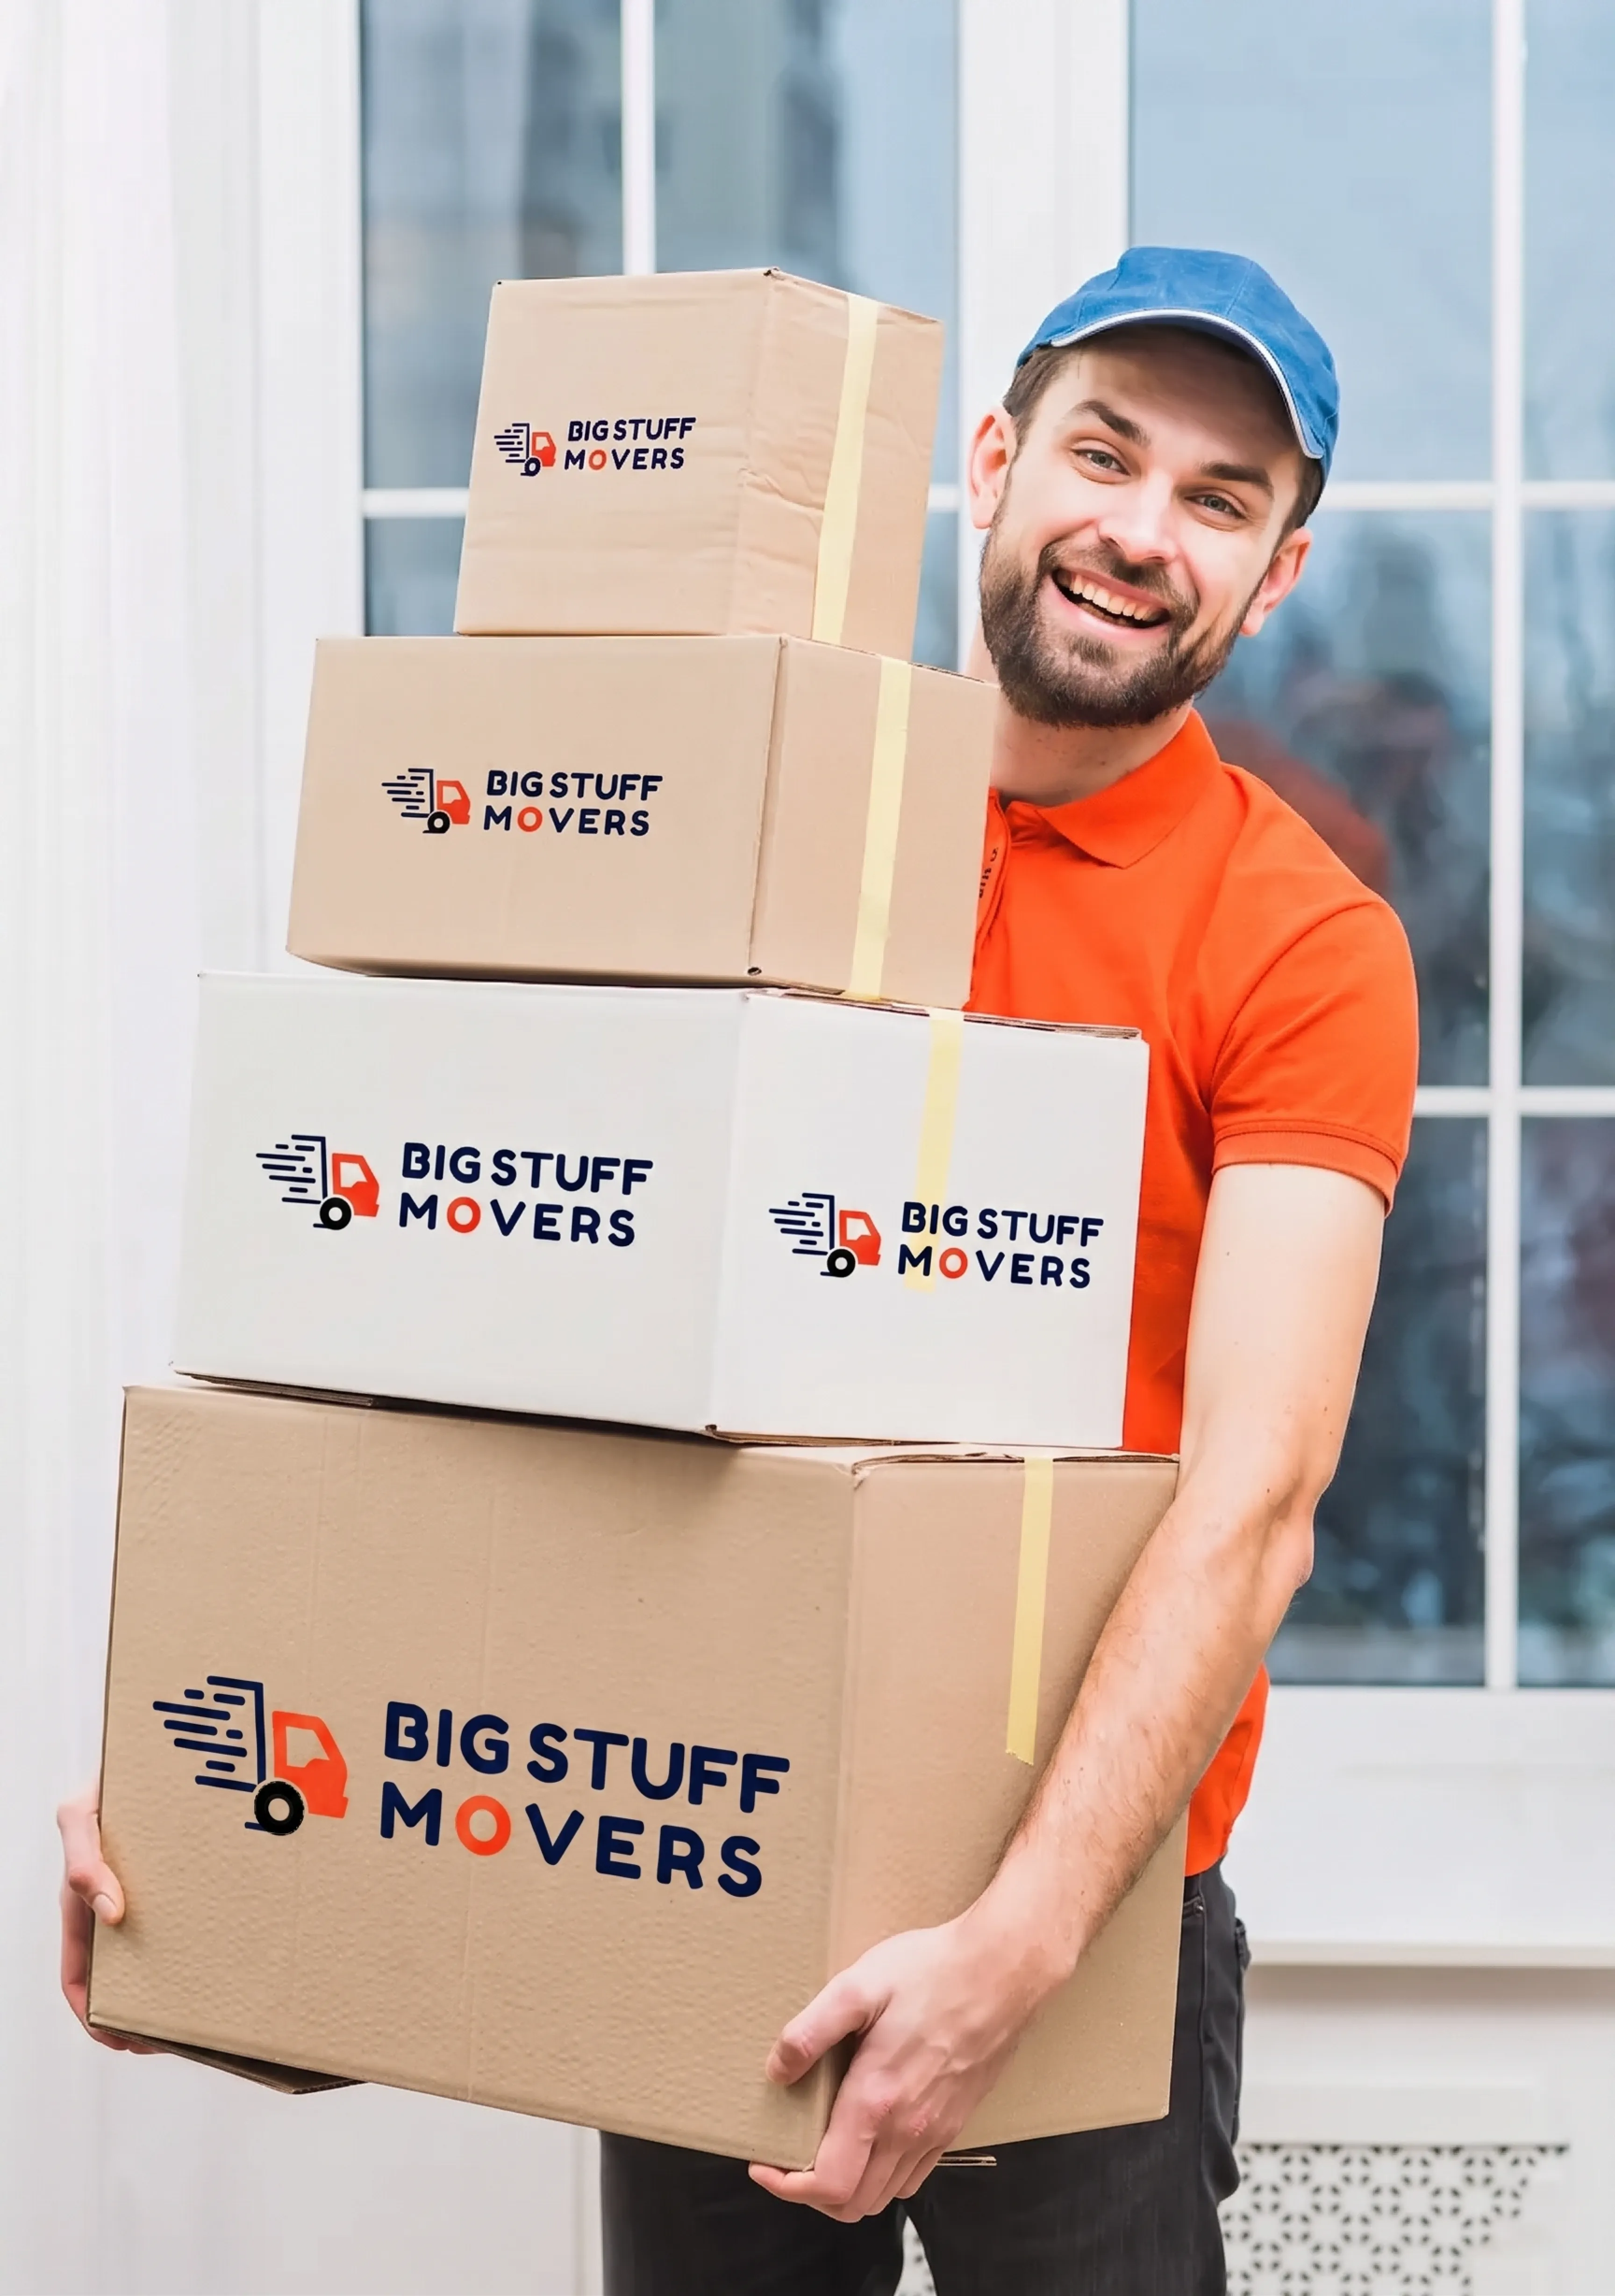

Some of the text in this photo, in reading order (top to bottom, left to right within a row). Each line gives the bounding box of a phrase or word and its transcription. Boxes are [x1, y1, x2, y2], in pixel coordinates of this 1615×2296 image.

[567, 416, 696, 442] BIG STUFF
[564, 447, 684, 470] MOVERS
[486, 769, 664, 801] BIG STUFF
[483, 805, 650, 837] MOVERS
[402, 1141, 653, 1196] BIG STUFF
[399, 1192, 636, 1247] MOVERS
[901, 1201, 1104, 1247] BIG STUFF
[897, 1243, 1091, 1289] MOVERS
[384, 1700, 791, 1814] BIG STUFF
[379, 1781, 763, 1898] MOVERS
